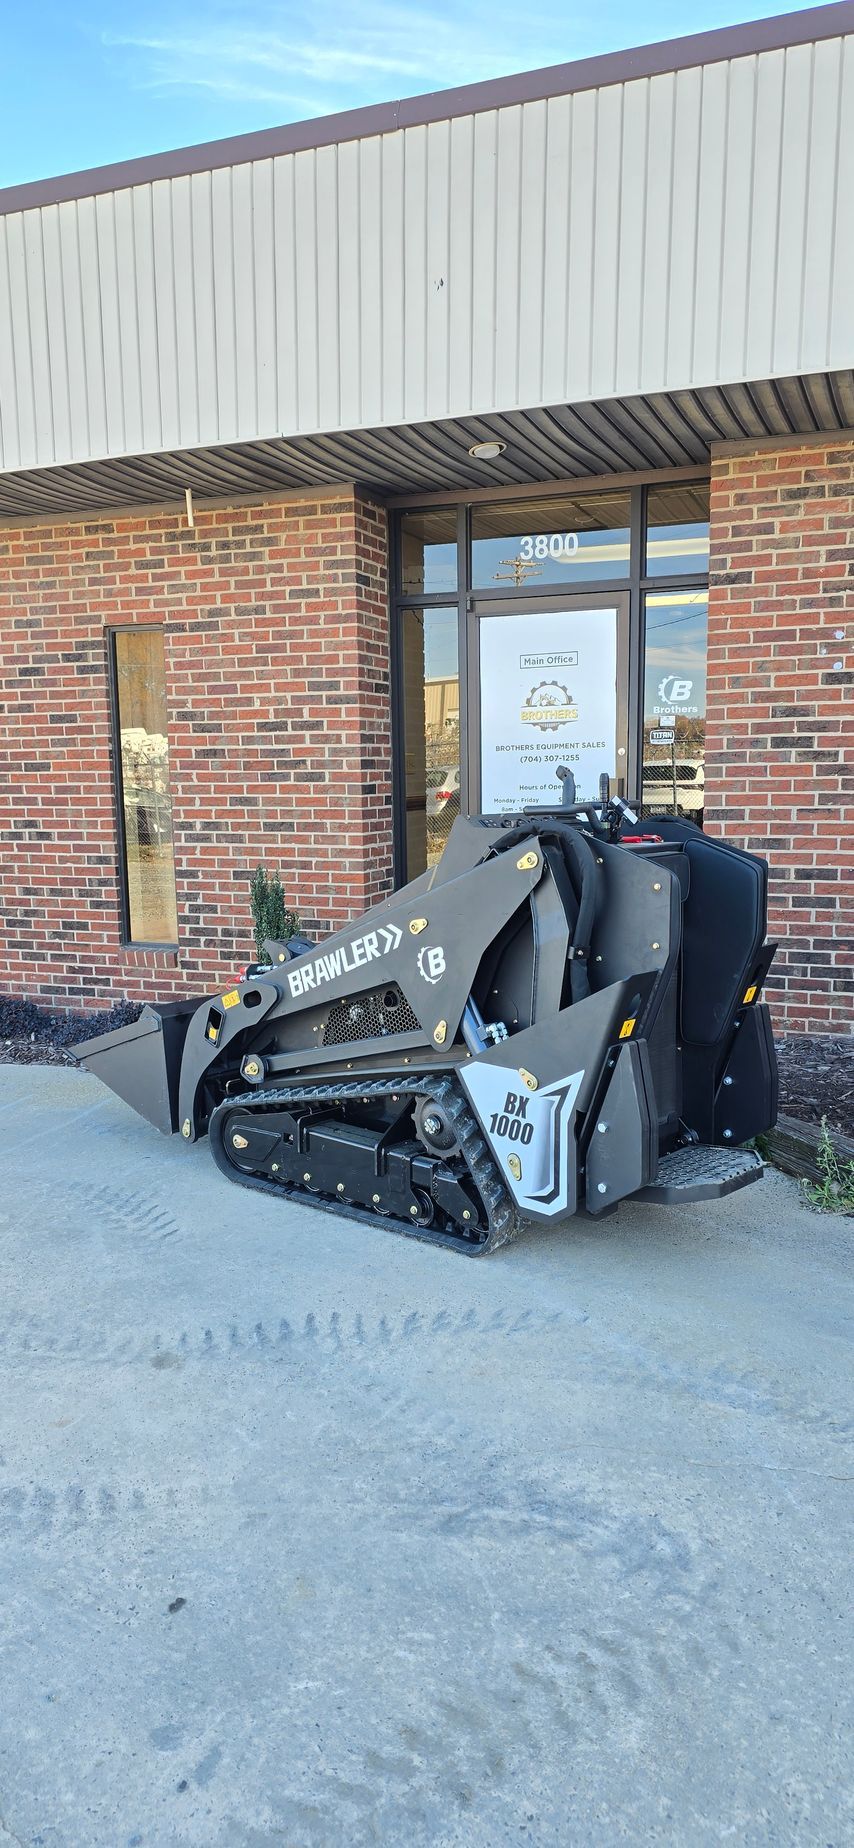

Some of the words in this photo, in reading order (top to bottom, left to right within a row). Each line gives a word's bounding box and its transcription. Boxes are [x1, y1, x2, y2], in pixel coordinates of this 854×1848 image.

[520, 532, 578, 560] 3800
[524, 657, 544, 666] Main
[547, 655, 574, 664] Office
[521, 709, 579, 721] BROTHERS
[653, 706, 698, 714] Brothers
[495, 744, 534, 752] BROTHERS
[536, 742, 580, 751] EQUIPMENT
[519, 755, 542, 764] (704)
[544, 754, 580, 762] 307-1255
[287, 931, 381, 998] BRAWLER
[504, 1091, 530, 1119] BX
[489, 1112, 535, 1146] 1000
